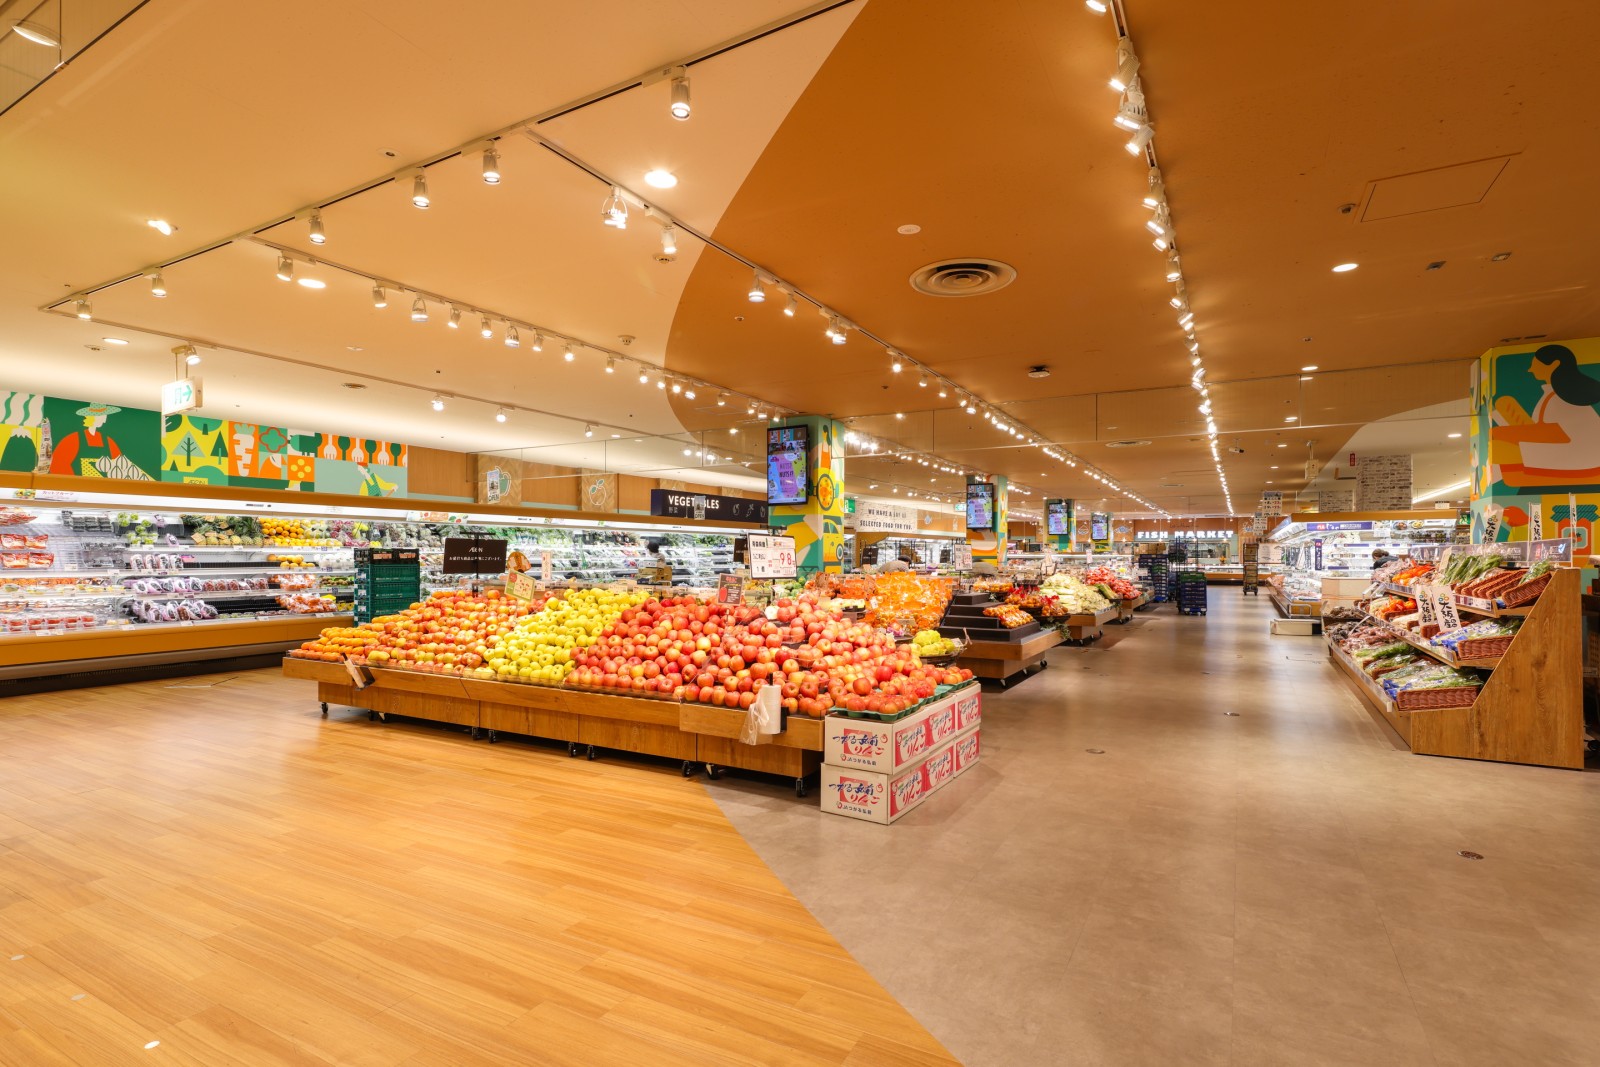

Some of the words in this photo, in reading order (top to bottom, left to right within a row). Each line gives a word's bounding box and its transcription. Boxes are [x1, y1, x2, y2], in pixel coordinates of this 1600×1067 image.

[668, 495, 719, 509] VEGETBLES
[875, 509, 888, 517] HAVE
[860, 520, 881, 528] SELECTED
[895, 522, 903, 530] FOR
[1137, 531, 1169, 539] FISH
[1174, 530, 1234, 539] MARKET
[832, 734, 879, 747] つがる弘前
[854, 745, 885, 756] りんご
[828, 783, 874, 796] つがる弘前
[850, 794, 880, 805] りんご
